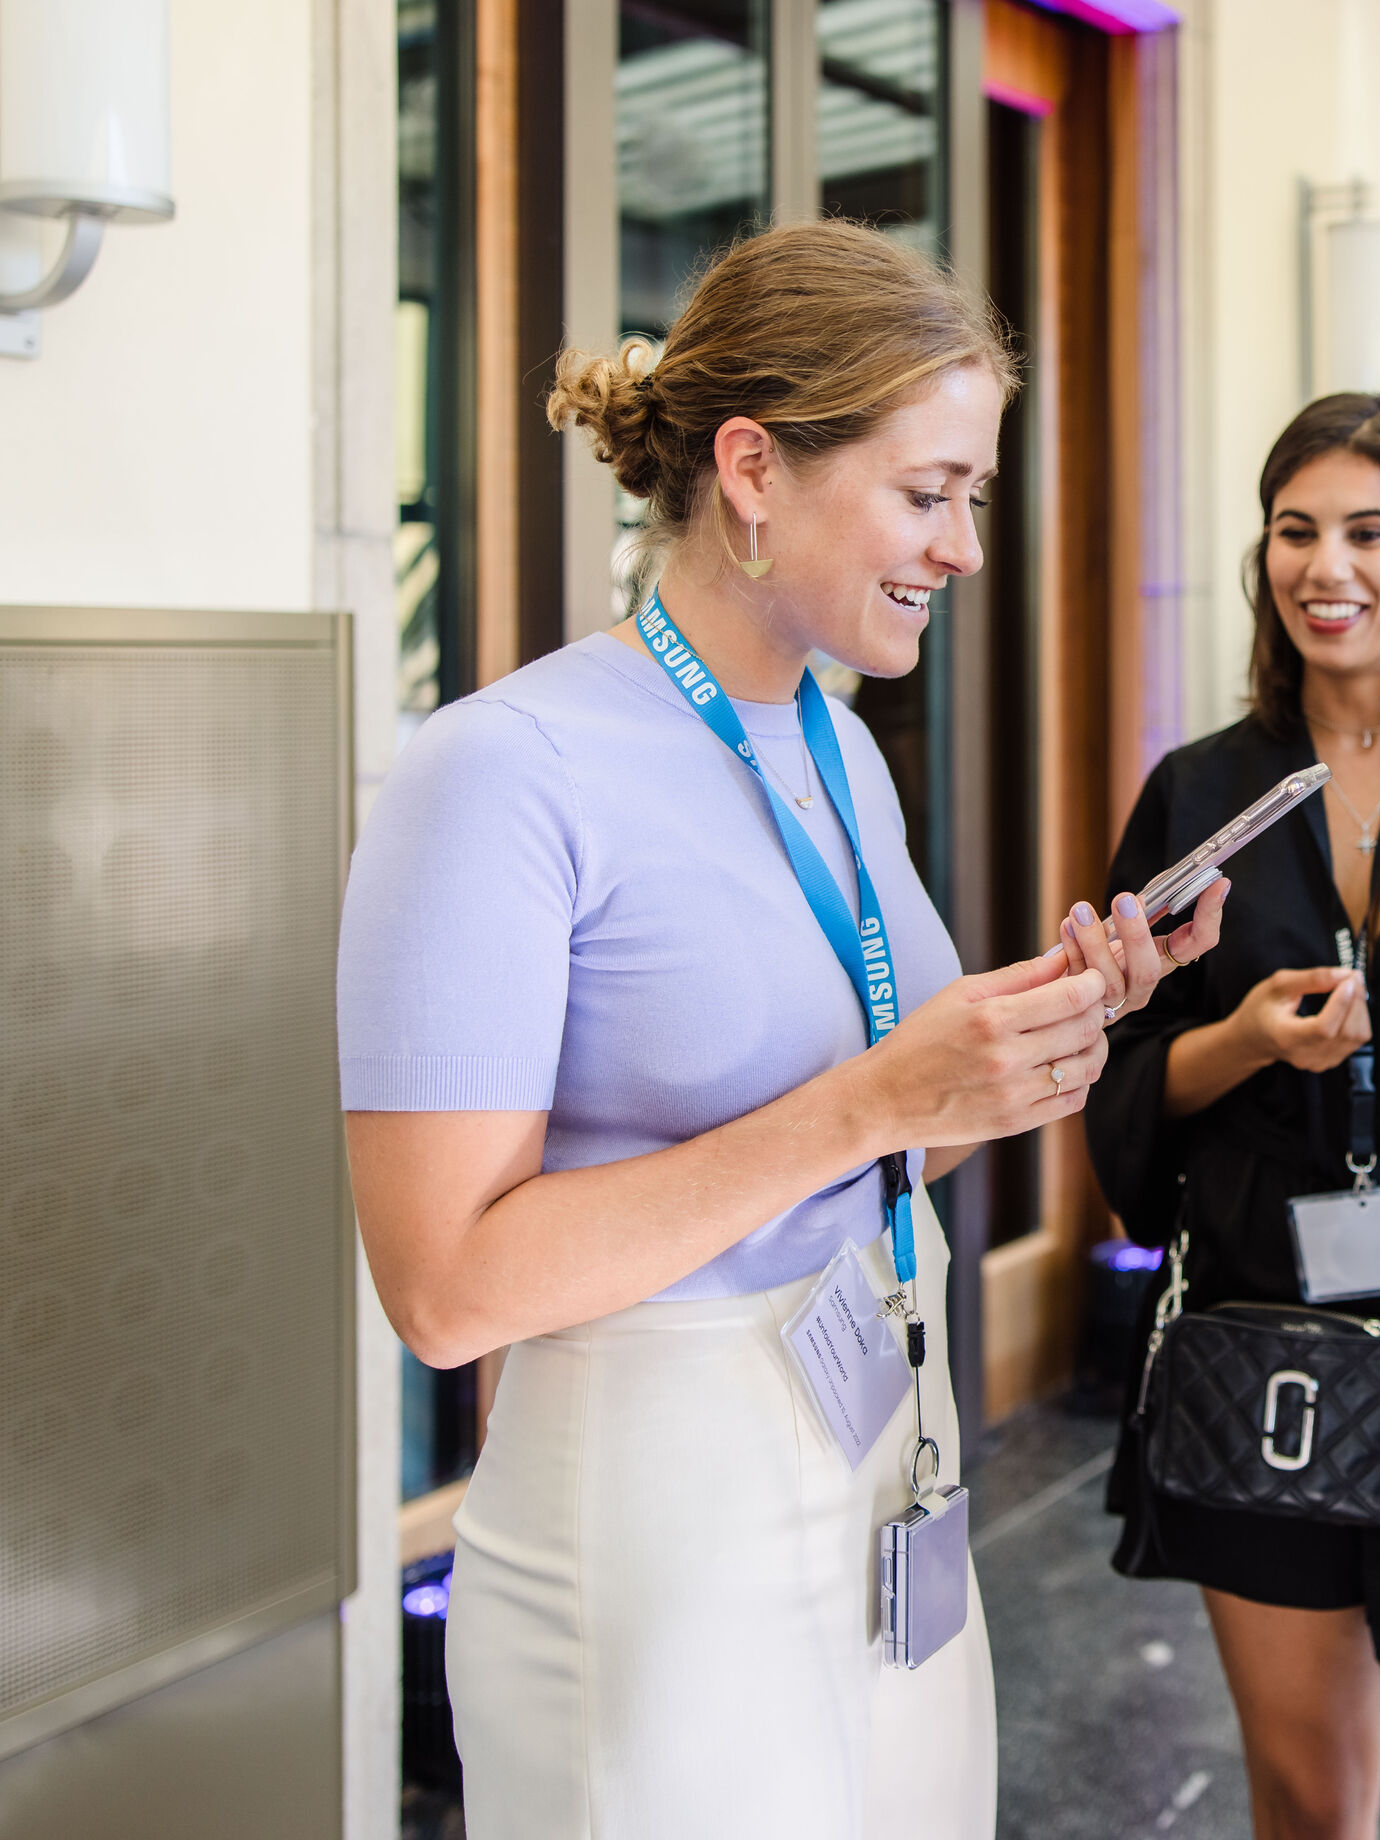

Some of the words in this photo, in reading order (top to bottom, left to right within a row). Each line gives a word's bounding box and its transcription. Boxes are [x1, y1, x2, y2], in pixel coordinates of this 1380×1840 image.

[640, 598, 717, 705] AMSUNG
[861, 917, 896, 1042] MSUNG
[806, 1329, 822, 1359] SAMSUNG
[829, 1295, 847, 1332] Samsung
[834, 1285, 856, 1329] Vivienne
[854, 1327, 868, 1356] Doka
[816, 1315, 848, 1382] #UnfoldYourWorld
